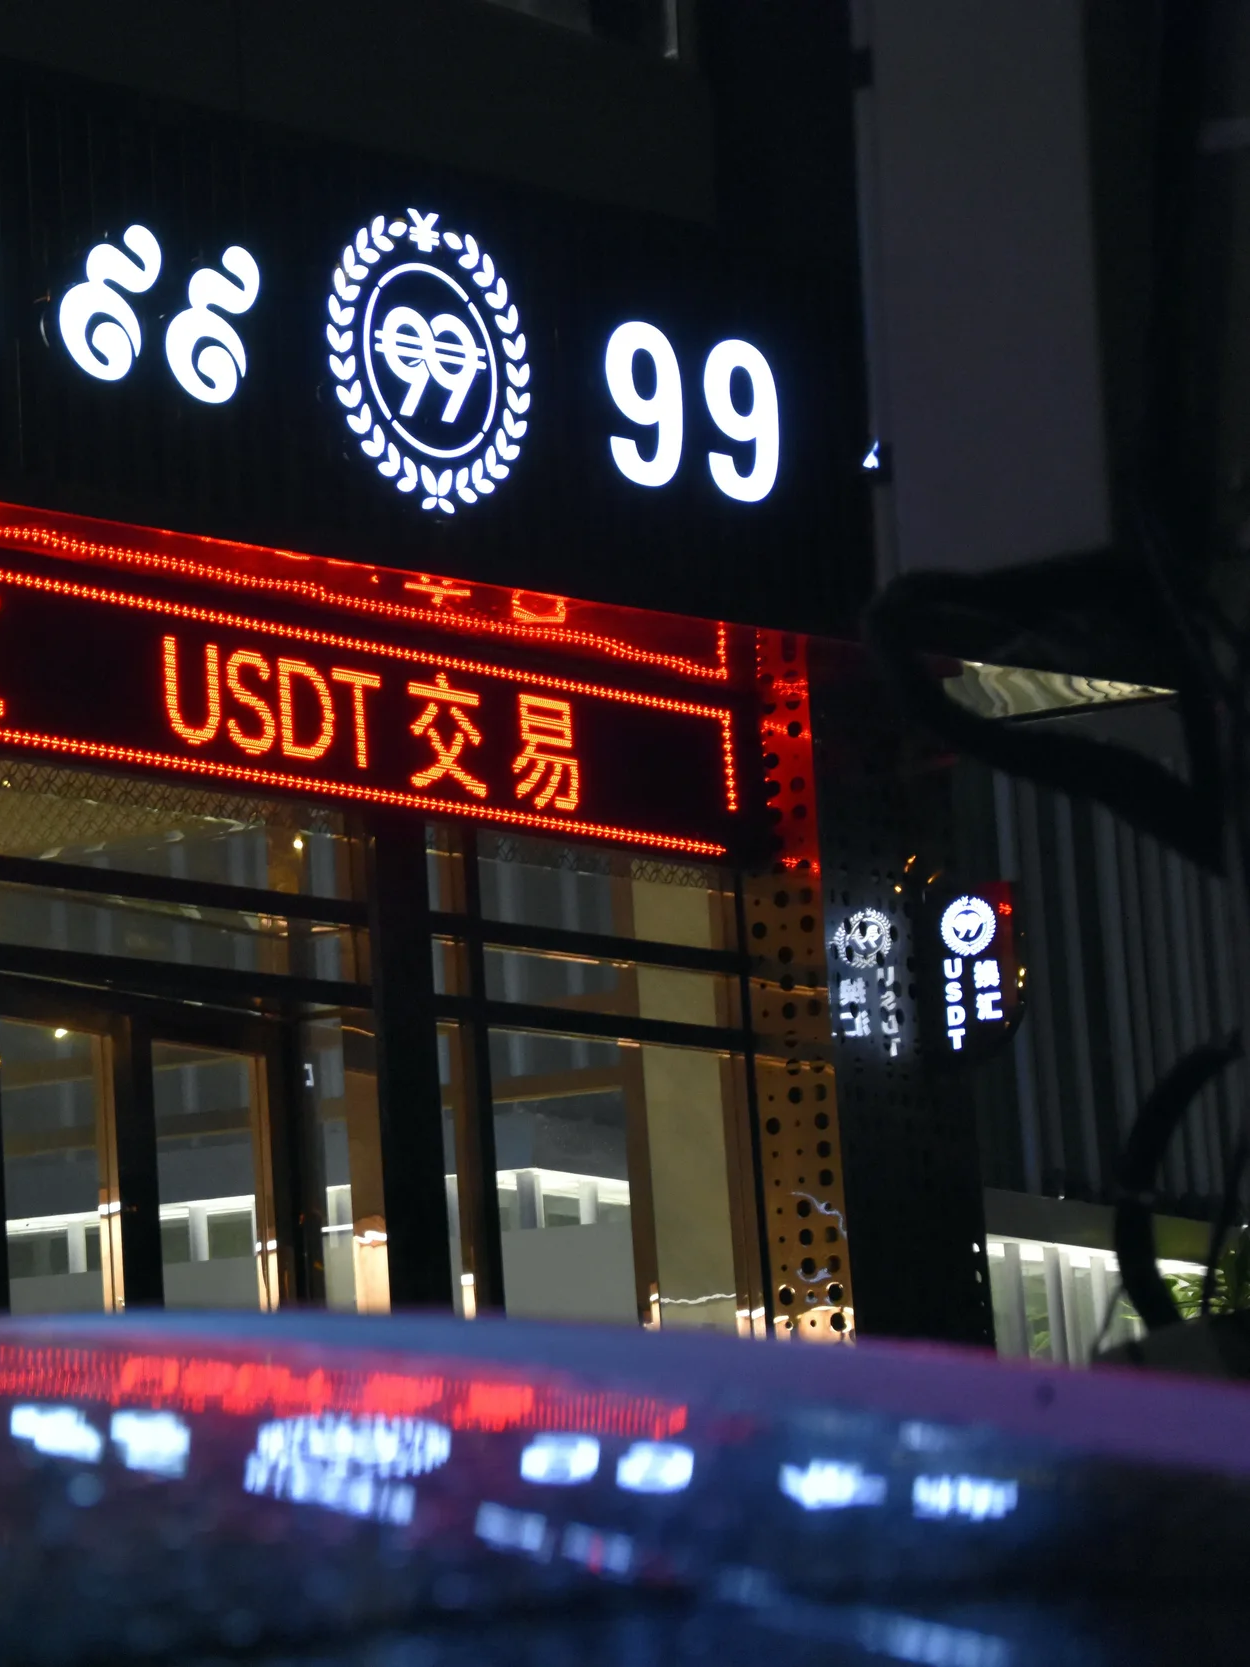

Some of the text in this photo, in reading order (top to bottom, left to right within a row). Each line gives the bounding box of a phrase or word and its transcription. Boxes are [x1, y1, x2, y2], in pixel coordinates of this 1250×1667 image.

[58, 224, 259, 405] ៩៩
[606, 321, 780, 503] 99
[162, 634, 381, 769] USDT
[406, 671, 580, 812] 交易
[943, 957, 967, 1051] USDT
